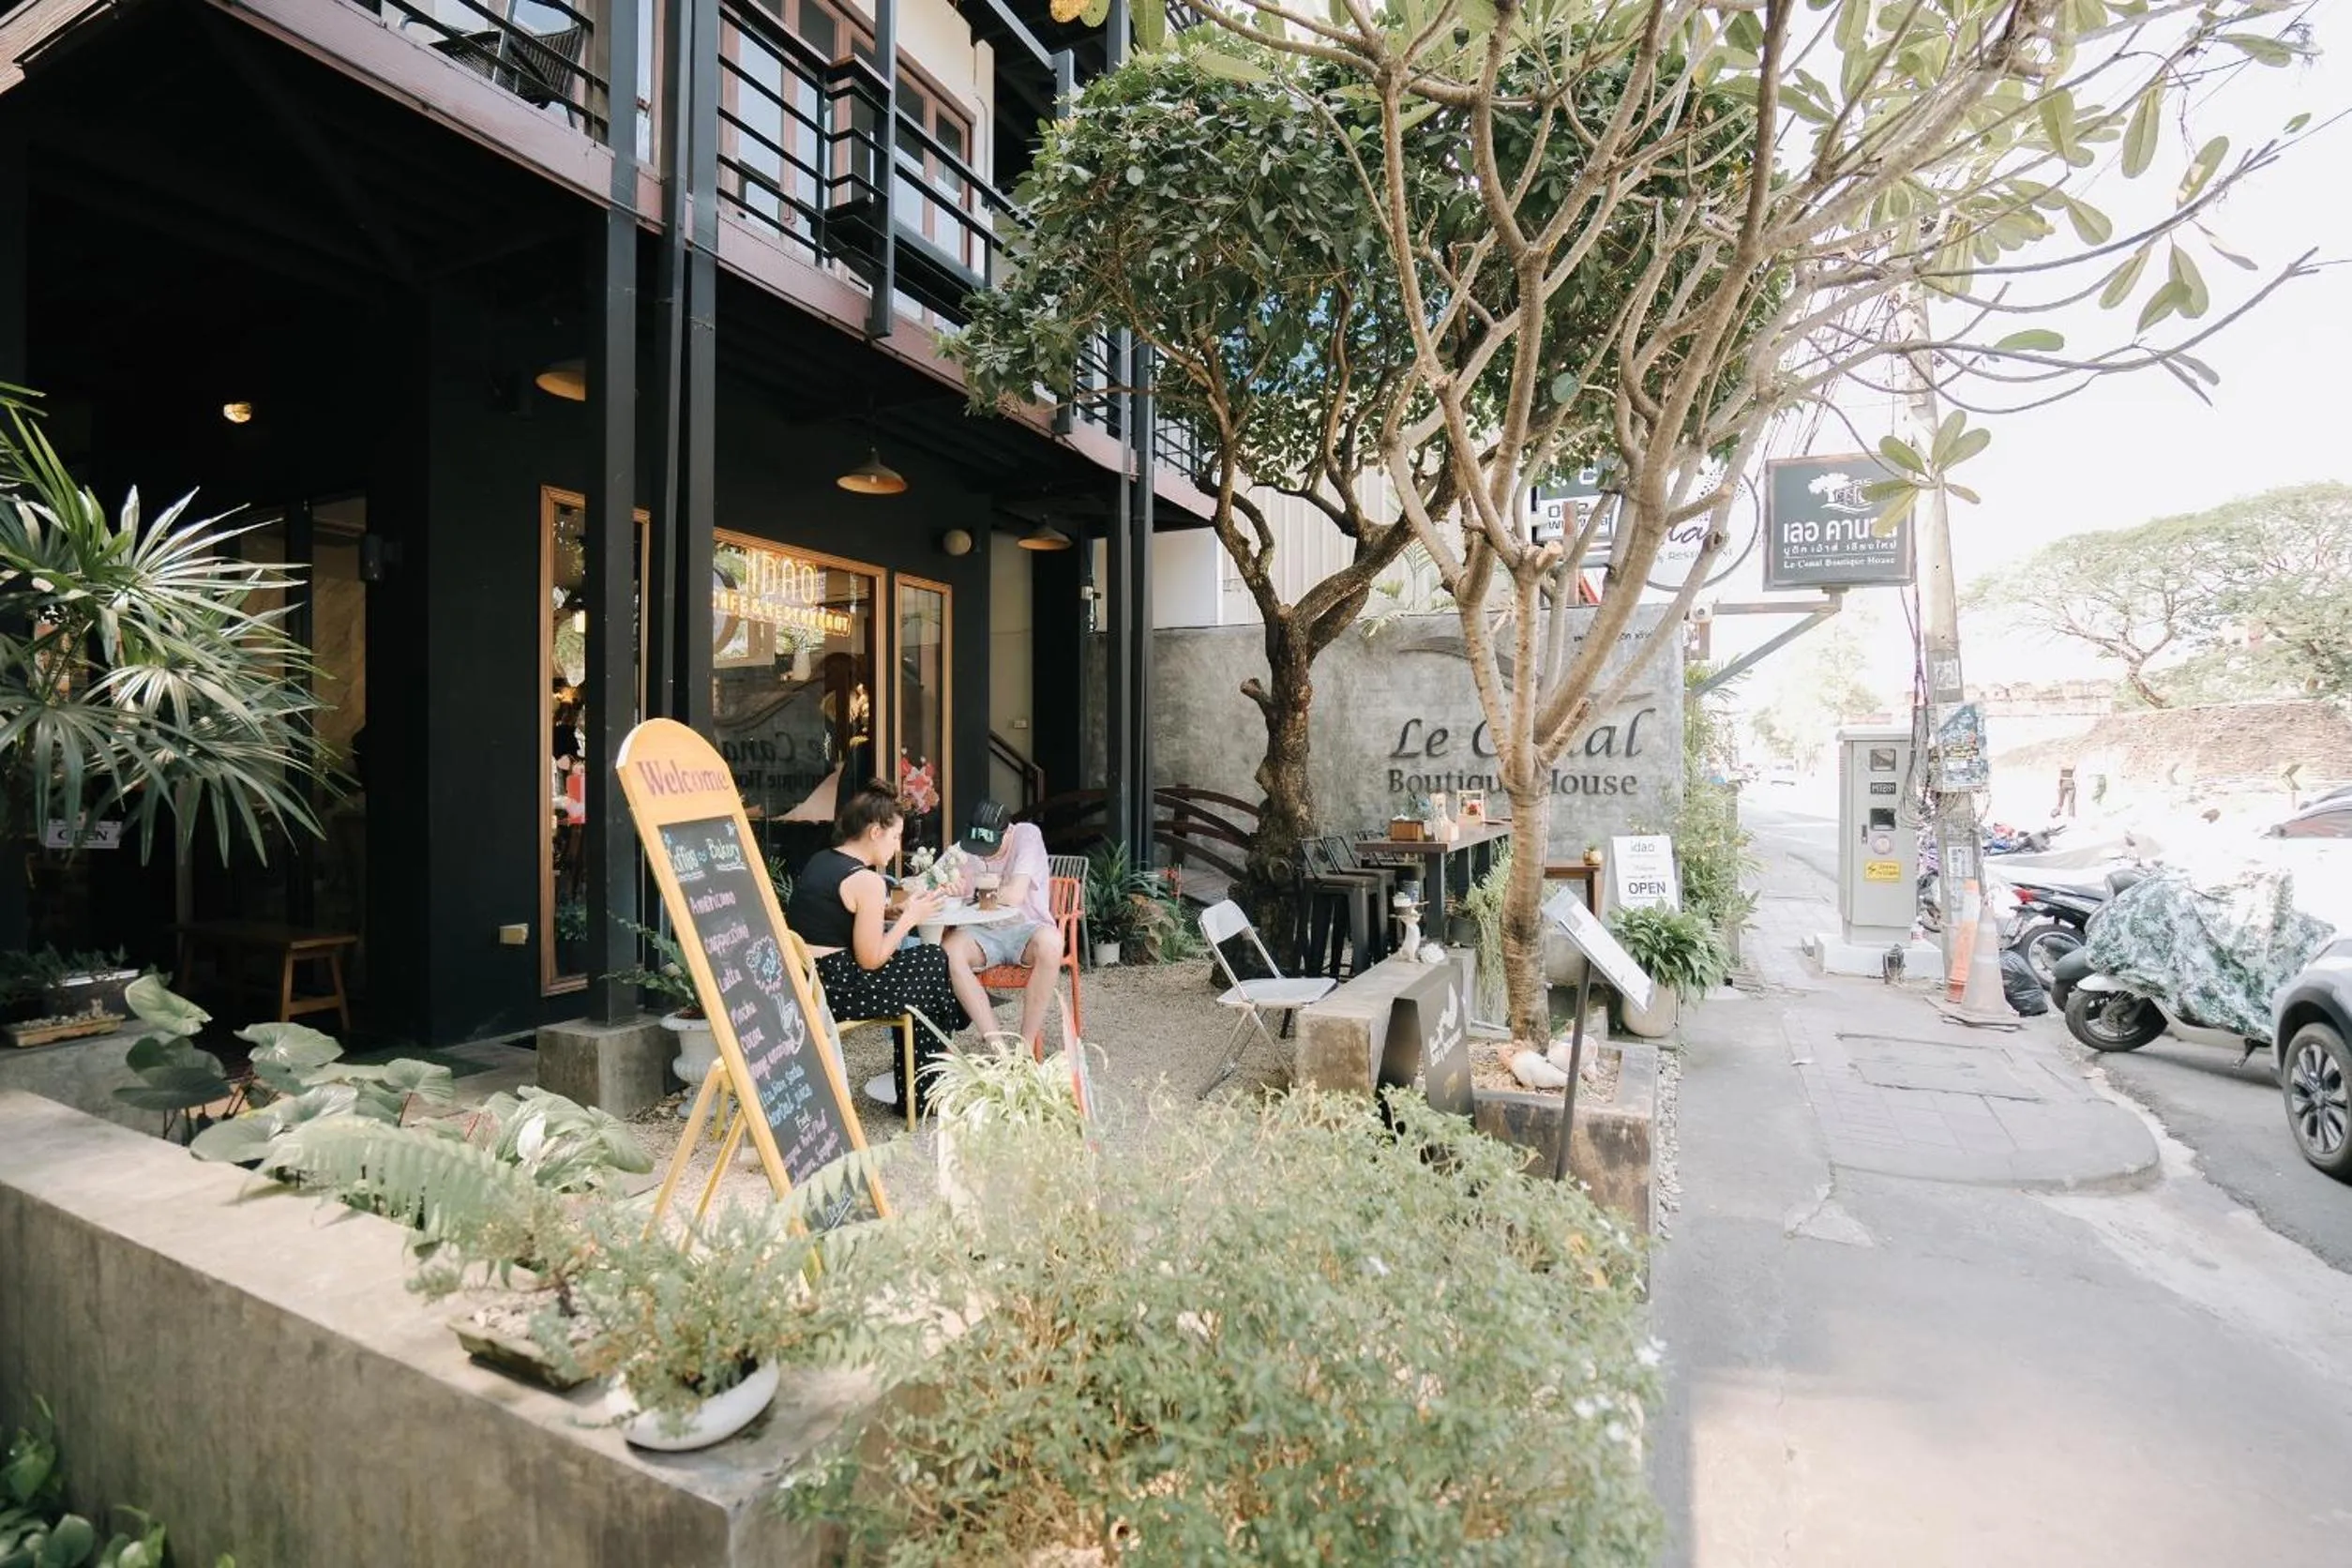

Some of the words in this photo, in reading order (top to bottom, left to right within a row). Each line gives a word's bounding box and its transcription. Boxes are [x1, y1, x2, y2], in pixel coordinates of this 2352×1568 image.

[1784, 521, 1819, 543] เลอ
[1389, 717, 1449, 758] Le
[1471, 707, 1657, 758] Cal
[636, 760, 731, 796] Welcome
[1388, 768, 1503, 796] Boutiqu
[1628, 882, 1666, 895] OPEN
